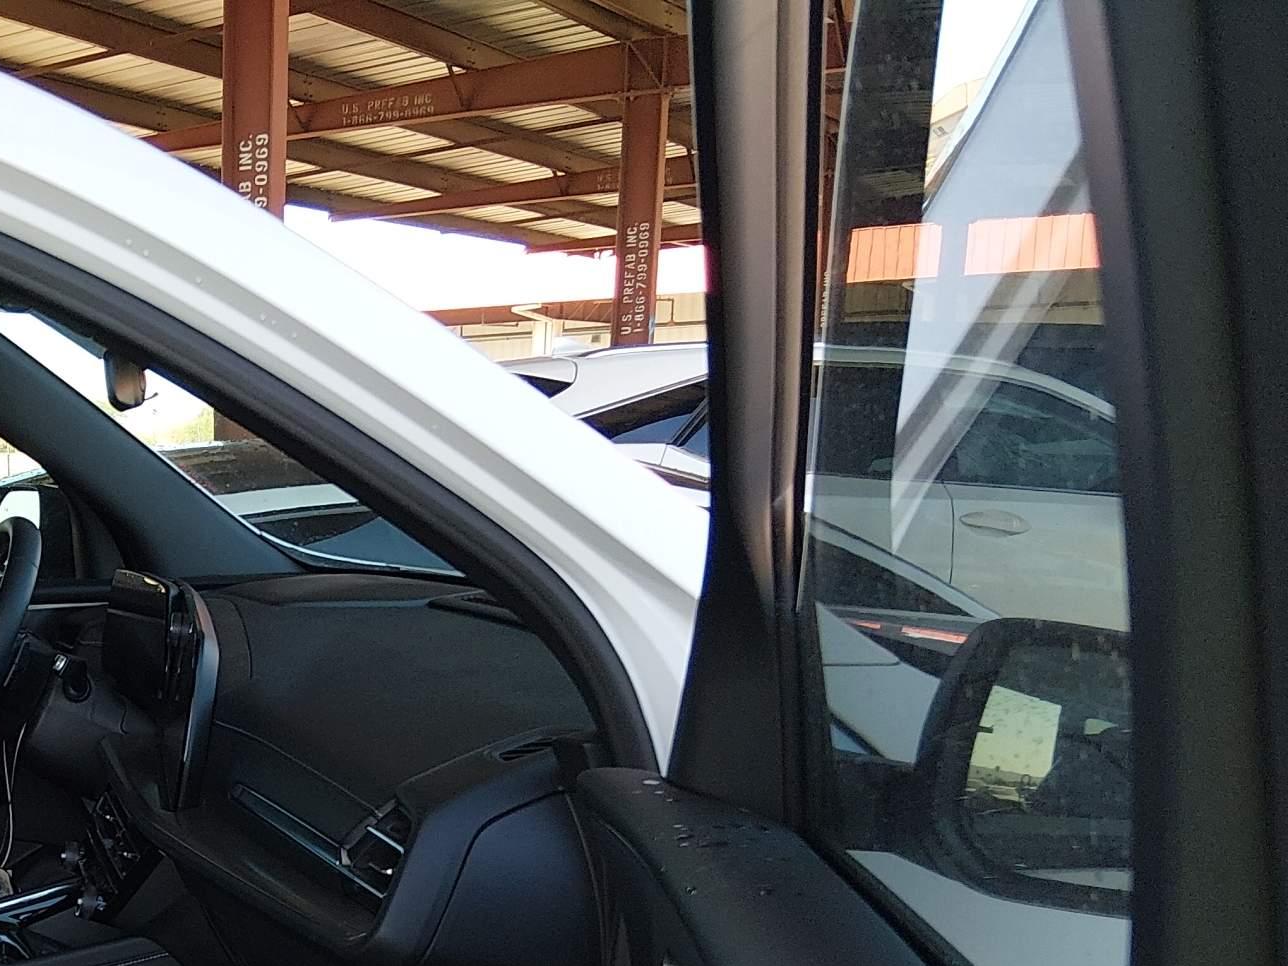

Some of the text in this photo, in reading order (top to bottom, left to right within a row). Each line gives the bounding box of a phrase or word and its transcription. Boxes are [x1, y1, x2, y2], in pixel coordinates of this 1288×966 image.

[239, 134, 253, 171] INC.
[622, 253, 636, 304] PREFAB
[632, 222, 650, 333] 1-866-799-0969
[620, 310, 633, 335] U.S.
